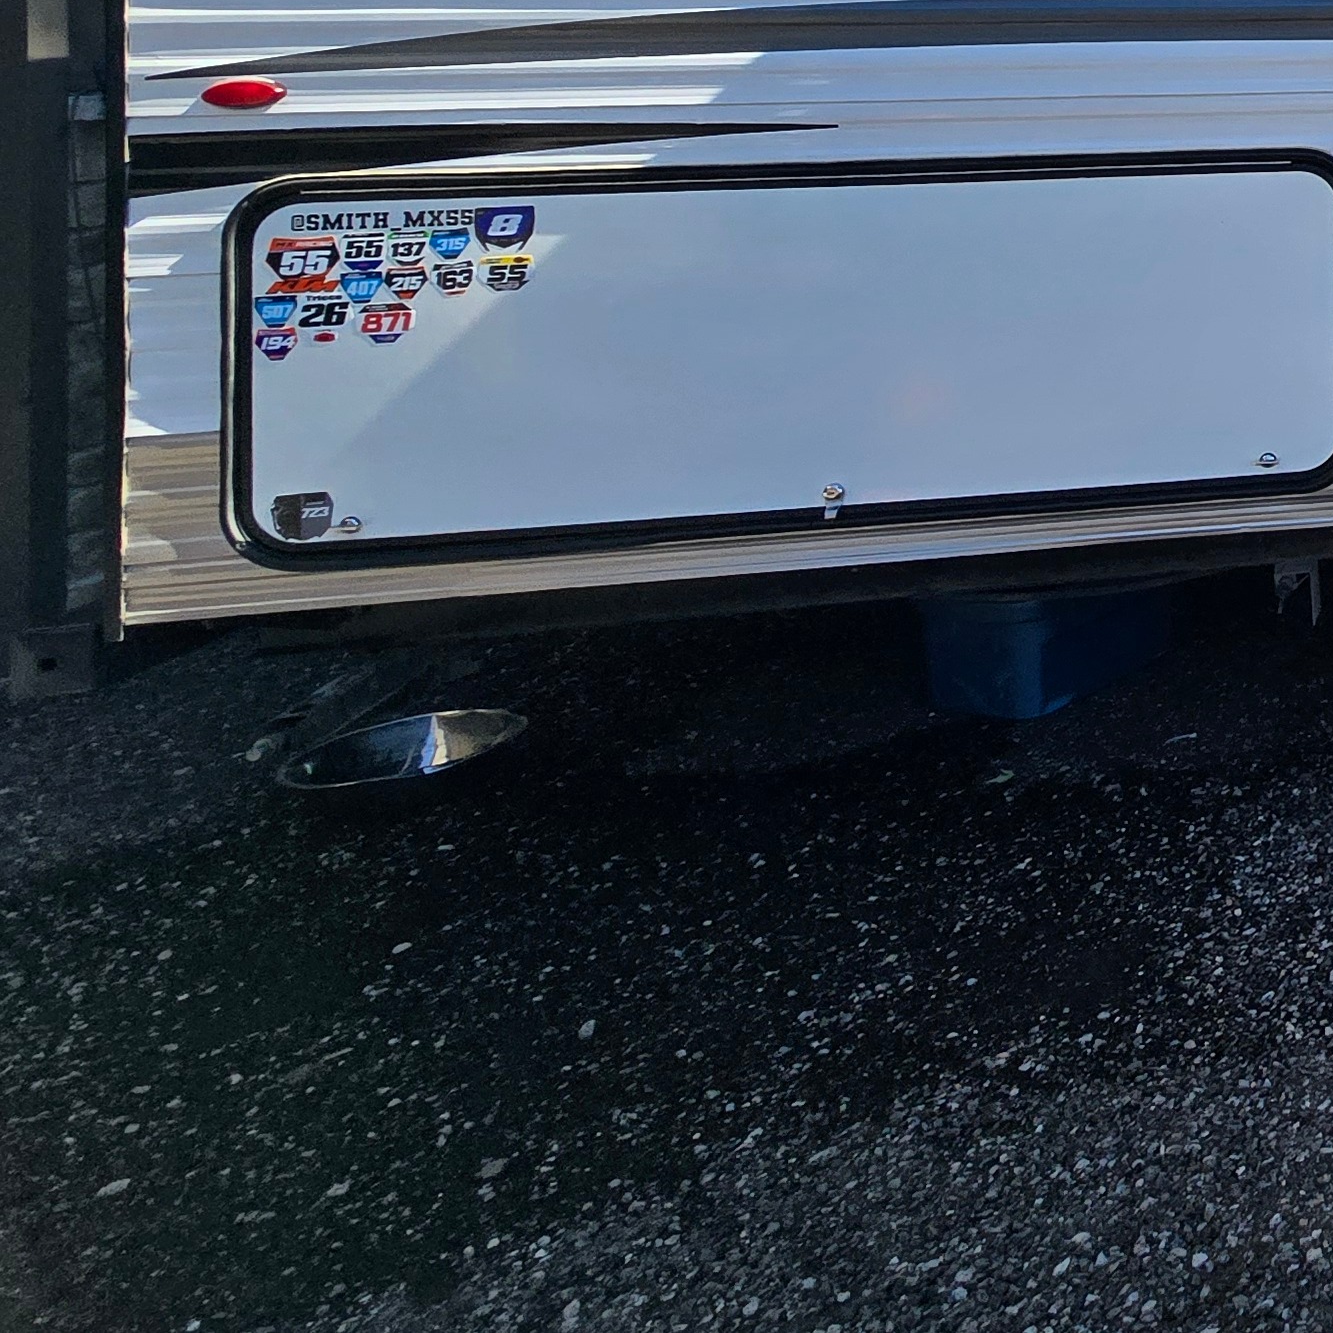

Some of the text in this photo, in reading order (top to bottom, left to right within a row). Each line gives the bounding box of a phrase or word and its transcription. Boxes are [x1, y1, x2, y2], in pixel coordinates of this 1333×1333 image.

[291, 209, 473, 232] @SMITH_MX55
[487, 215, 523, 236] 8
[345, 240, 384, 258] 55
[391, 242, 426, 257] 137
[436, 237, 467, 252] 315
[279, 250, 332, 276] 55
[436, 269, 473, 290] 163
[487, 264, 528, 283] 55
[266, 279, 340, 294] KTM
[347, 280, 379, 296] 407
[390, 275, 424, 291] 215
[261, 304, 293, 319] 507
[299, 302, 350, 328] 26
[361, 312, 412, 333] 871
[261, 336, 297, 350] 194
